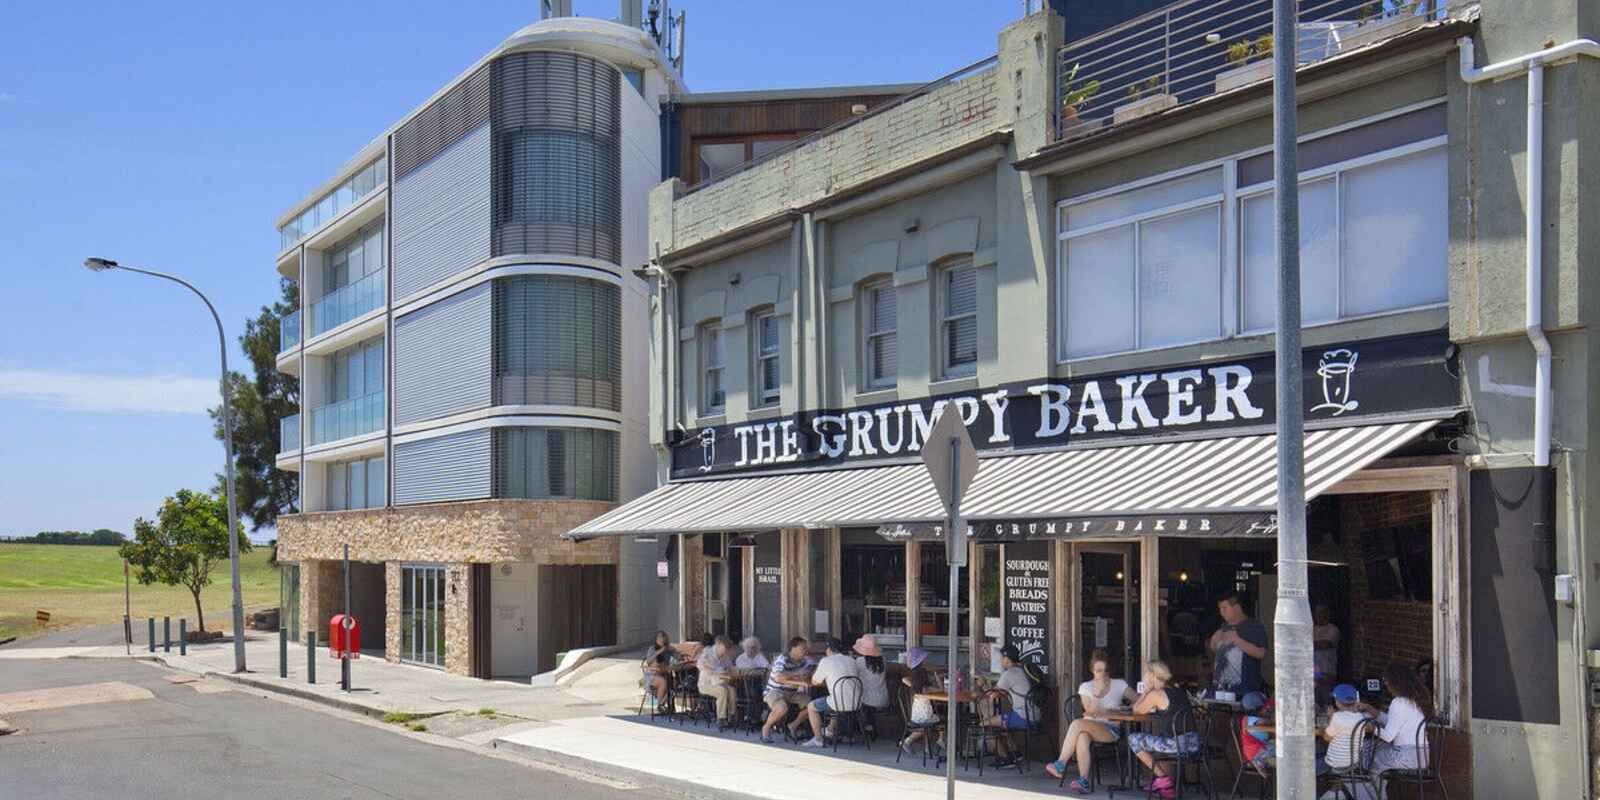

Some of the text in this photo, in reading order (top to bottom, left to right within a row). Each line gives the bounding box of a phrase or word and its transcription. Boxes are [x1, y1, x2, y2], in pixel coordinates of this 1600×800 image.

[734, 364, 1264, 467] THE GRUMPY BAKER
[995, 521, 1091, 534] GRUMPY
[1115, 519, 1211, 531] BAKER
[1006, 560, 1048, 570] SOURDOUGH
[1006, 576, 1033, 587] GLUTEN
[1010, 589, 1048, 599] BREADS
[1011, 602, 1046, 612] PASTRIES
[1018, 615, 1037, 625] PIES
[1011, 627, 1045, 638] COFFEE
